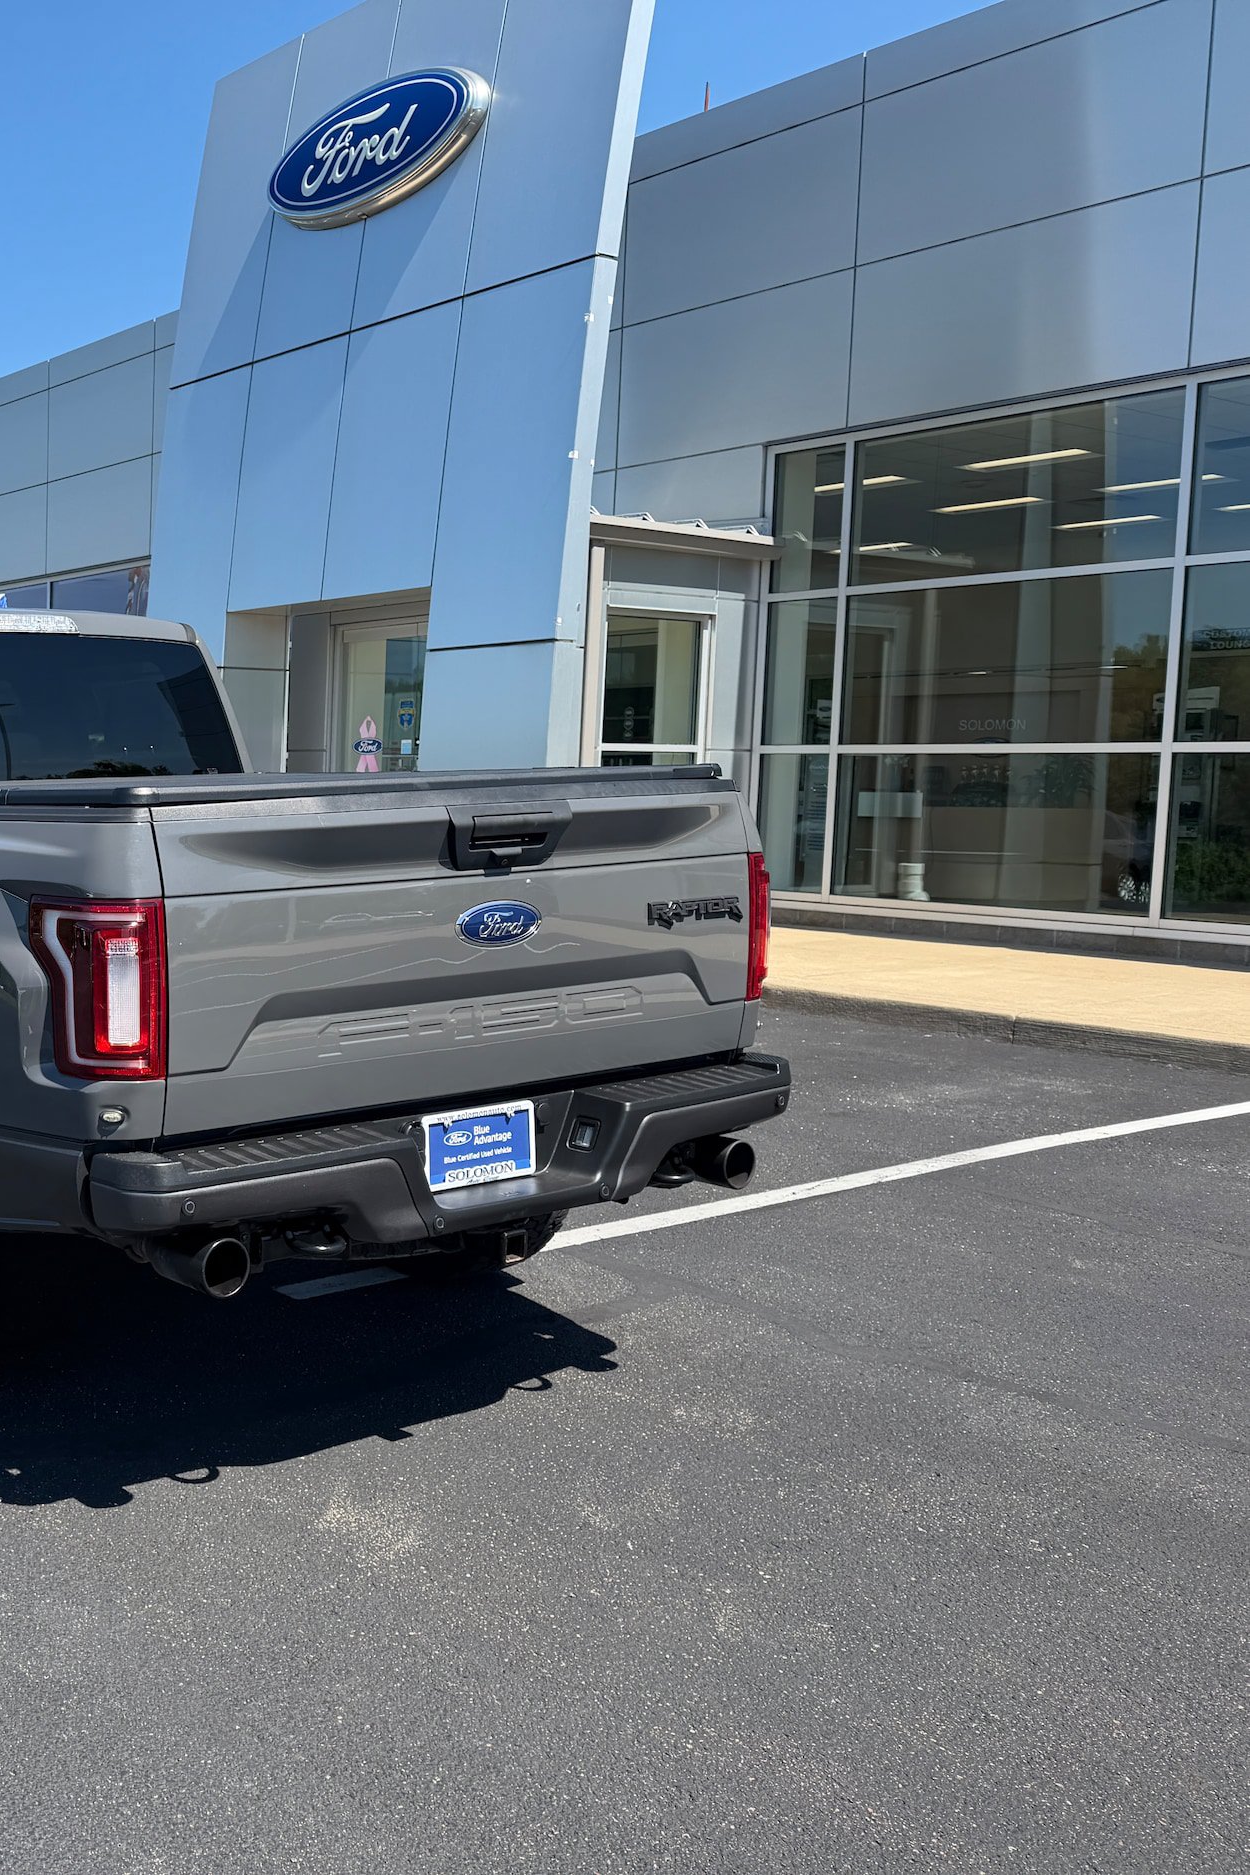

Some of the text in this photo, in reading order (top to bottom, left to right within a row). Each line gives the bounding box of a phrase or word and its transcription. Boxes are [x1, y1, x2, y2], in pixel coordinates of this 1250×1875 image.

[301, 102, 419, 197] Ford
[958, 719, 1027, 731] SOLOMON
[647, 896, 743, 930] RAPTOR
[479, 911, 524, 937] Ford
[318, 985, 644, 1057] F-150
[473, 1125, 490, 1135] Blue
[473, 1131, 512, 1146] Advantage
[444, 1146, 512, 1164] Blue Certified Used Vehicle
[448, 1162, 514, 1182] SOLOMON
